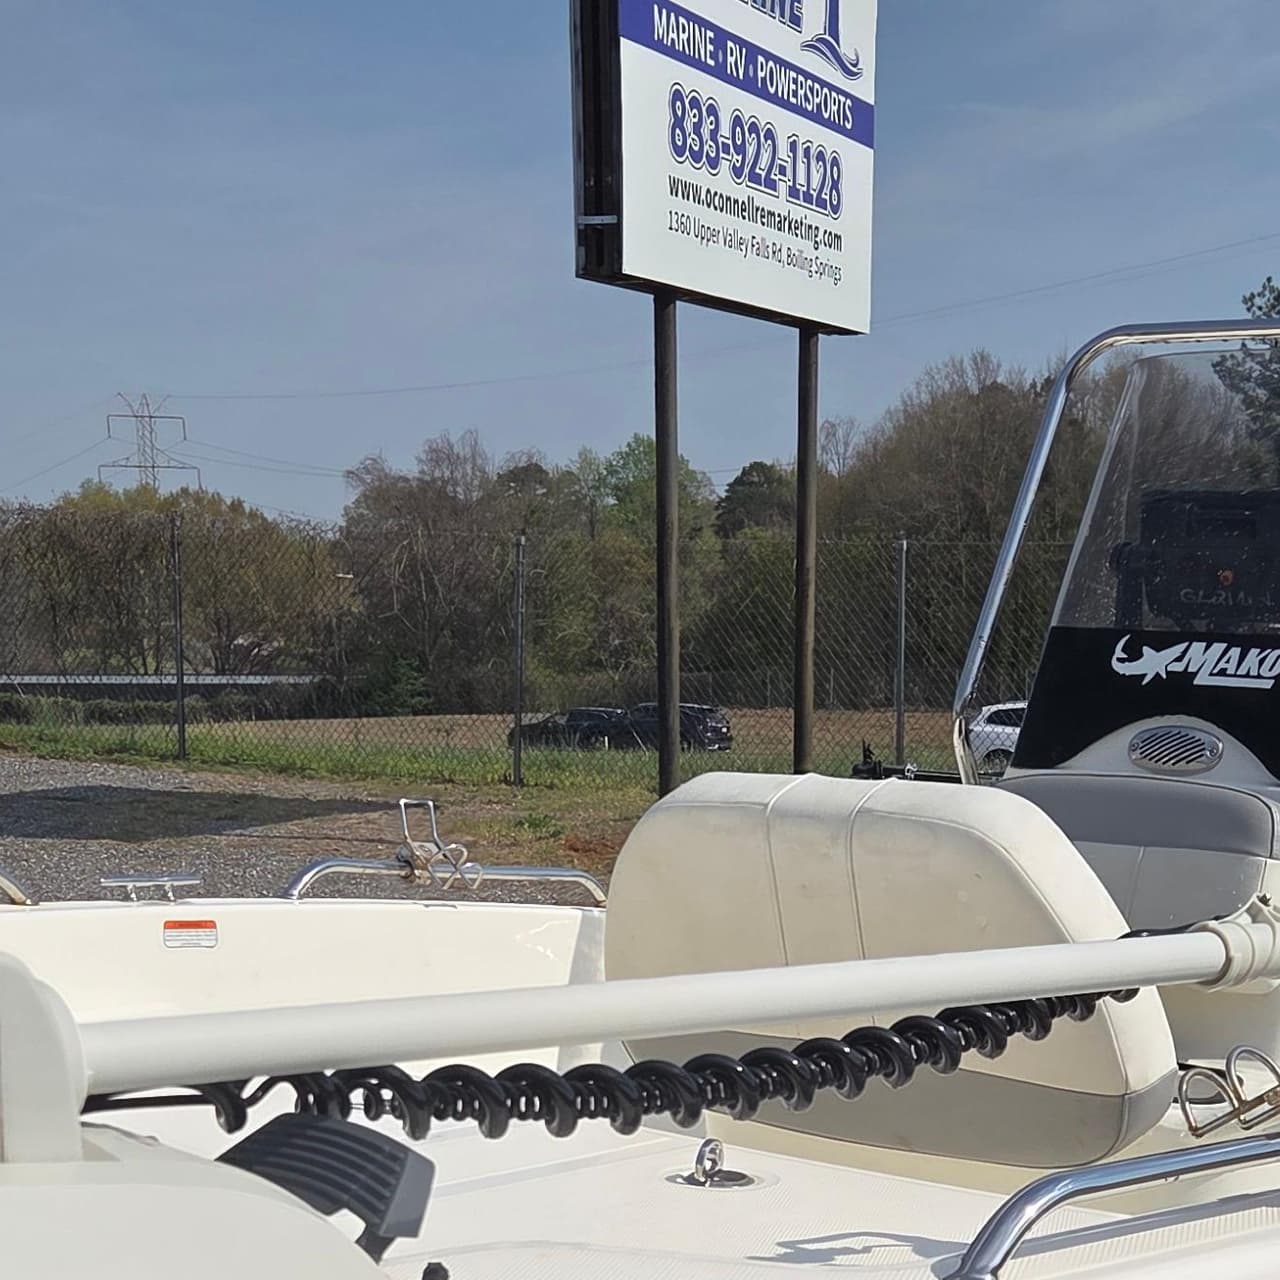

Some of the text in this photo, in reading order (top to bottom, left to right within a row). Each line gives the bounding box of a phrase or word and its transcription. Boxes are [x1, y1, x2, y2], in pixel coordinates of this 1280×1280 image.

[654, 4, 715, 67] MARINE
[727, 40, 746, 80] RV
[757, 55, 853, 130] POWERSPORTS
[669, 82, 843, 220] 833-922-1128
[668, 175, 843, 252] www.oconnellremarketing.com
[668, 210, 692, 236] 1360
[693, 217, 721, 247] Upper
[722, 226, 750, 258] Valley
[750, 235, 770, 260] Falls
[814, 255, 842, 286] Springs
